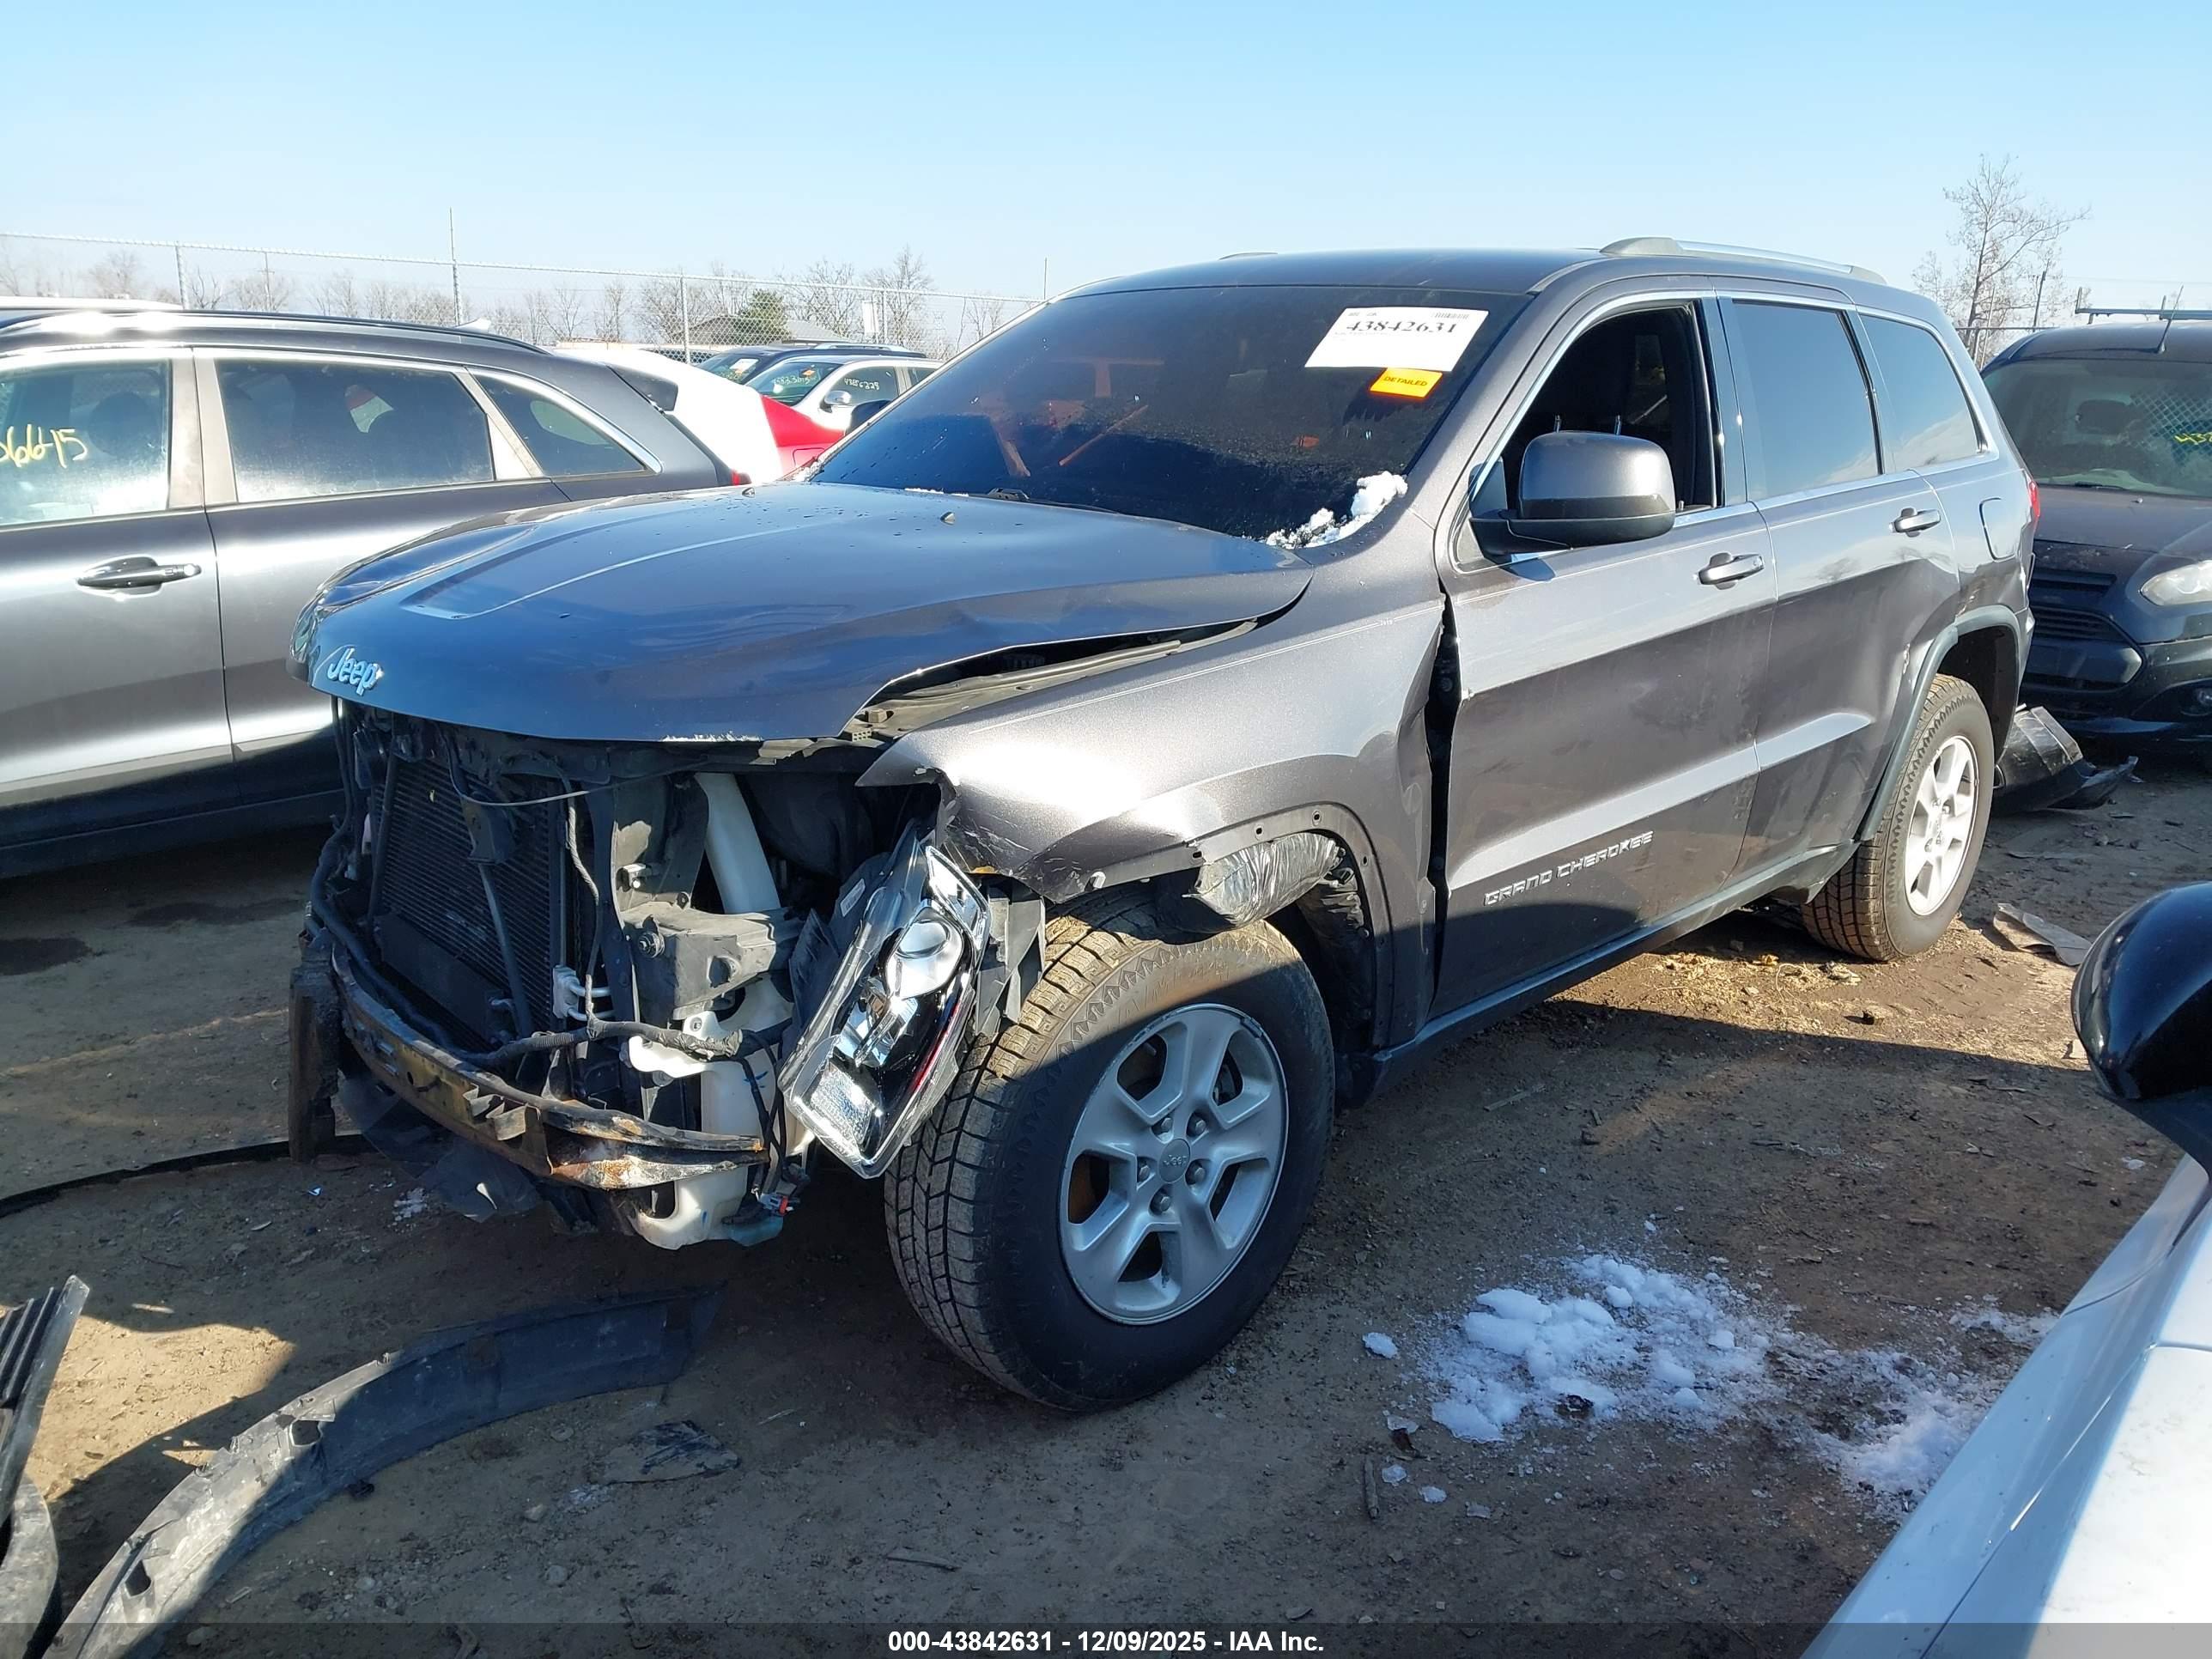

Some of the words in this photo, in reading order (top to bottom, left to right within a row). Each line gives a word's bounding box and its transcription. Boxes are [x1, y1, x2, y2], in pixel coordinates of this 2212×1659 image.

[1346, 320, 1457, 334] 43842631
[1383, 375, 1428, 387] DETAILED
[327, 647, 385, 696] Jeep
[1483, 869, 1553, 906] GRAND
[1556, 830, 1654, 878] CHEROKEE
